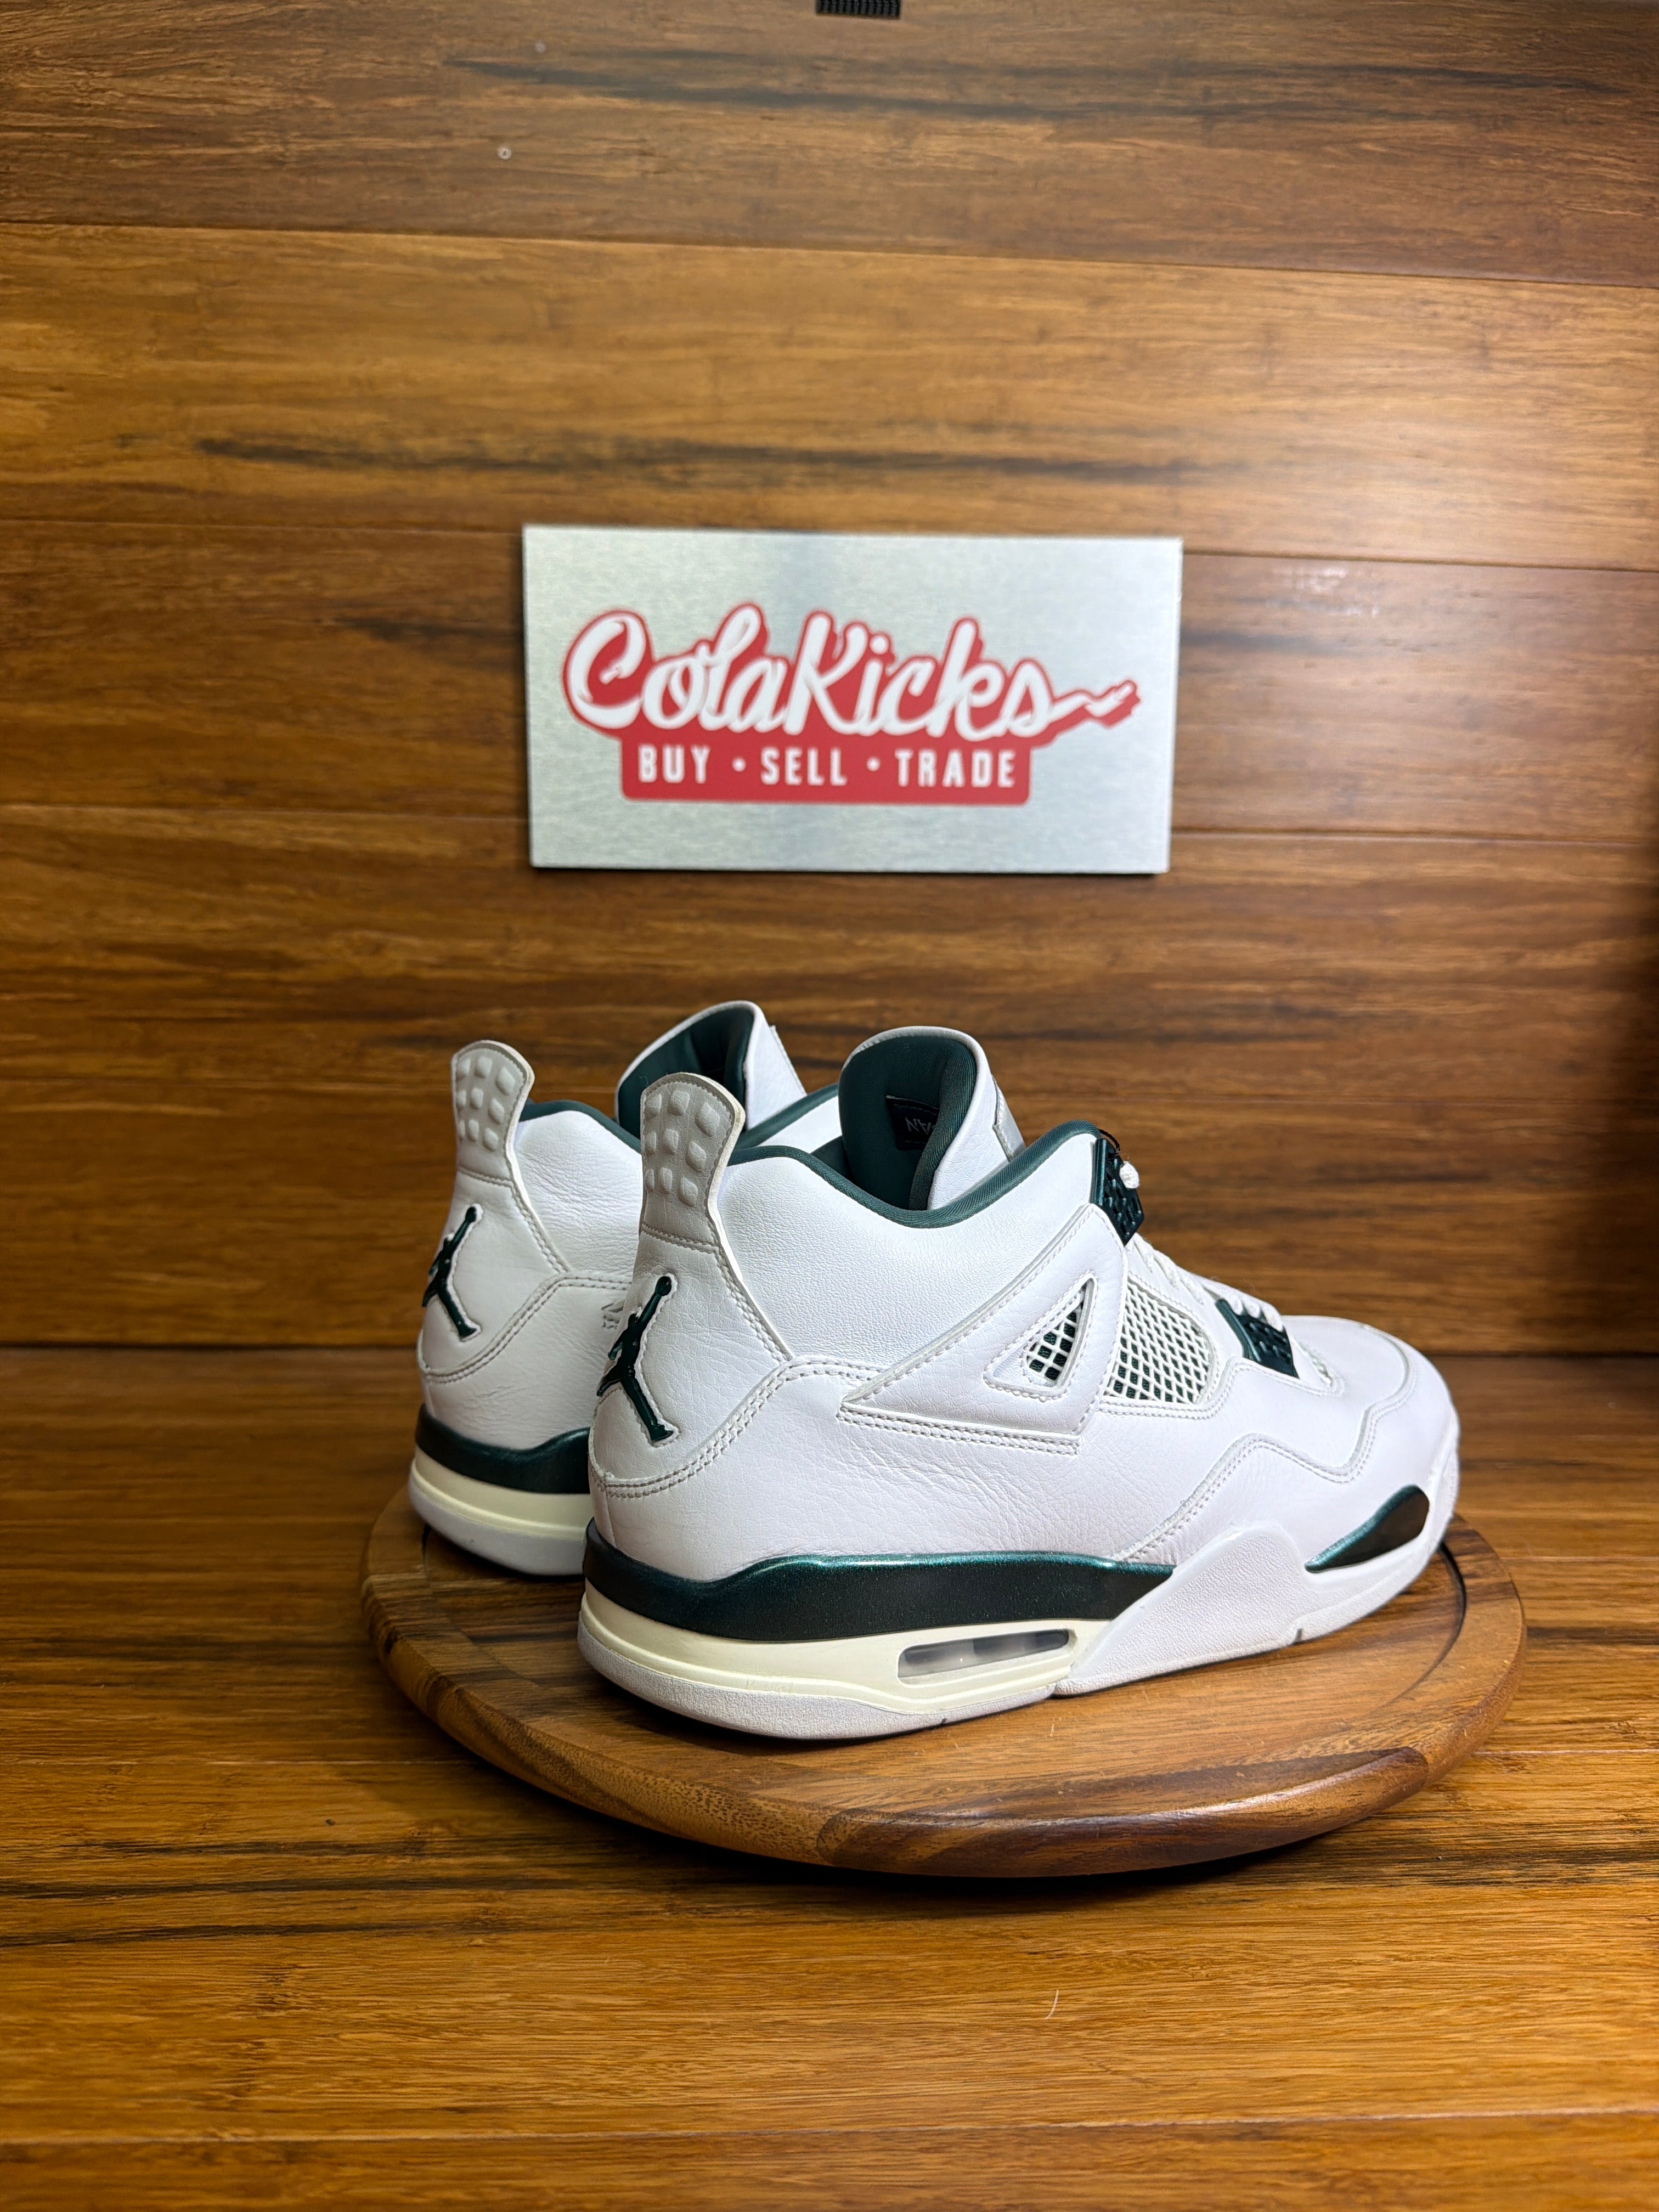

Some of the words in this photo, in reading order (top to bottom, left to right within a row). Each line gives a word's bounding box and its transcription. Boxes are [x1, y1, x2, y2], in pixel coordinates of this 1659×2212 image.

[564, 603, 1138, 742] ColaKicks
[637, 743, 710, 784] BUY
[760, 746, 848, 787] SELL
[894, 748, 1016, 788] TRADE
